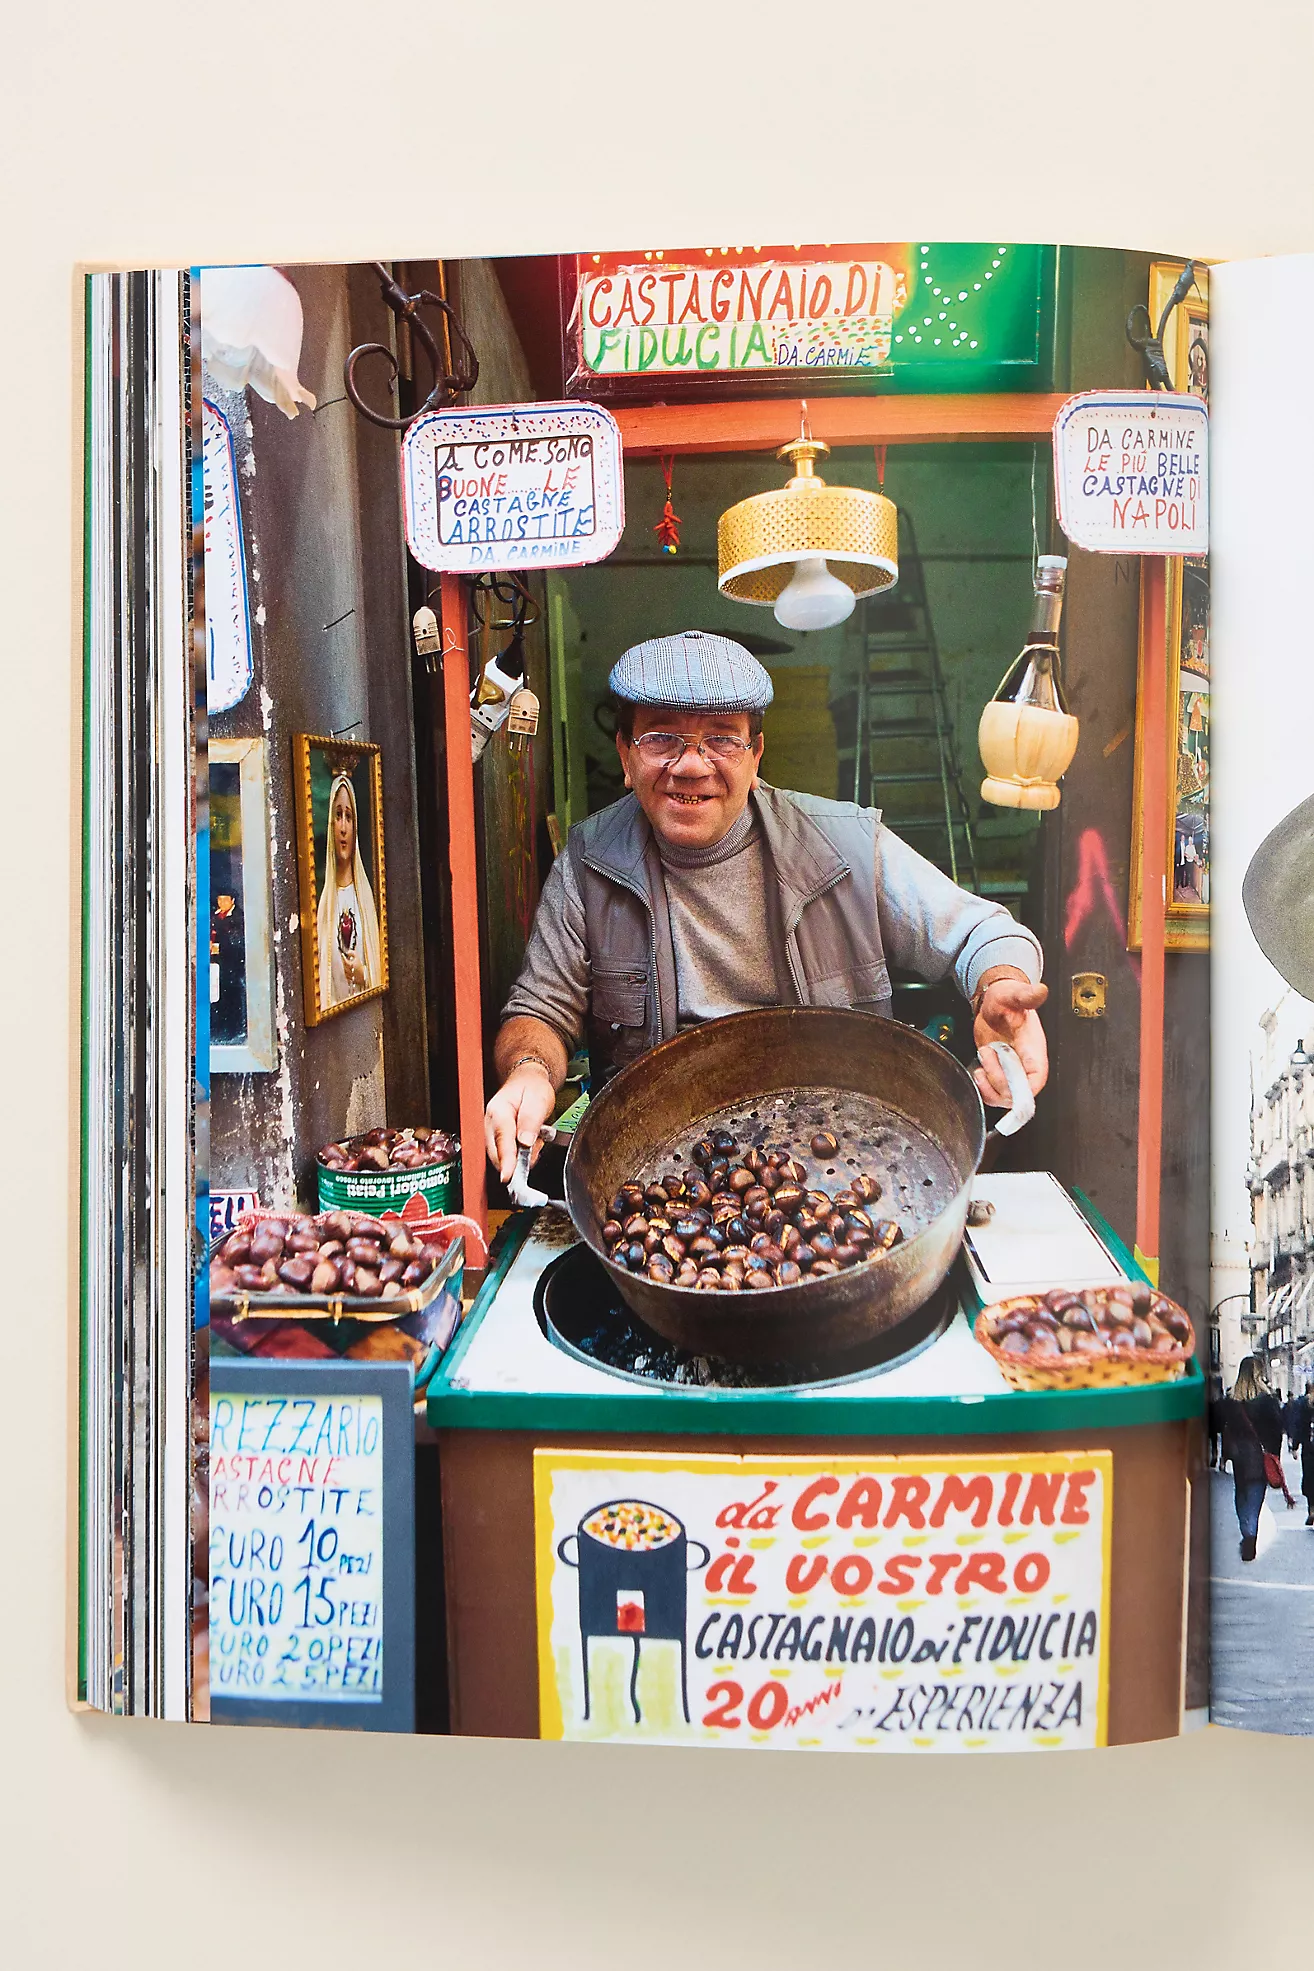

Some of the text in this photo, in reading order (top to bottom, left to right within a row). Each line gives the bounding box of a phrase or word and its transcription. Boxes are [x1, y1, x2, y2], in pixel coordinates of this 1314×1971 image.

[1121, 428, 1195, 450] CARMINE
[1083, 454, 1111, 473] LE
[1157, 452, 1200, 478] BELLE
[544, 466, 581, 493] LE
[1083, 475, 1185, 498] CASTAGNE
[454, 490, 573, 517] CASTAGNE
[1113, 497, 1197, 531] NAPOLI
[446, 504, 593, 544] ARROSTITE
[507, 541, 581, 560] CARMINE
[347, 1183, 386, 1198] Pelati
[360, 1175, 395, 1185] lavorato
[390, 1171, 450, 1198] Pomodori
[715, 1470, 1096, 1531] da CARMINE
[297, 1518, 339, 1571] 10
[293, 1575, 336, 1629] 15
[694, 1612, 915, 1663] CASTAGNAIO
[952, 1611, 1097, 1663] FIDUCIA
[702, 1680, 789, 1731] 20
[875, 1680, 1083, 1732] ESPERIENZA
